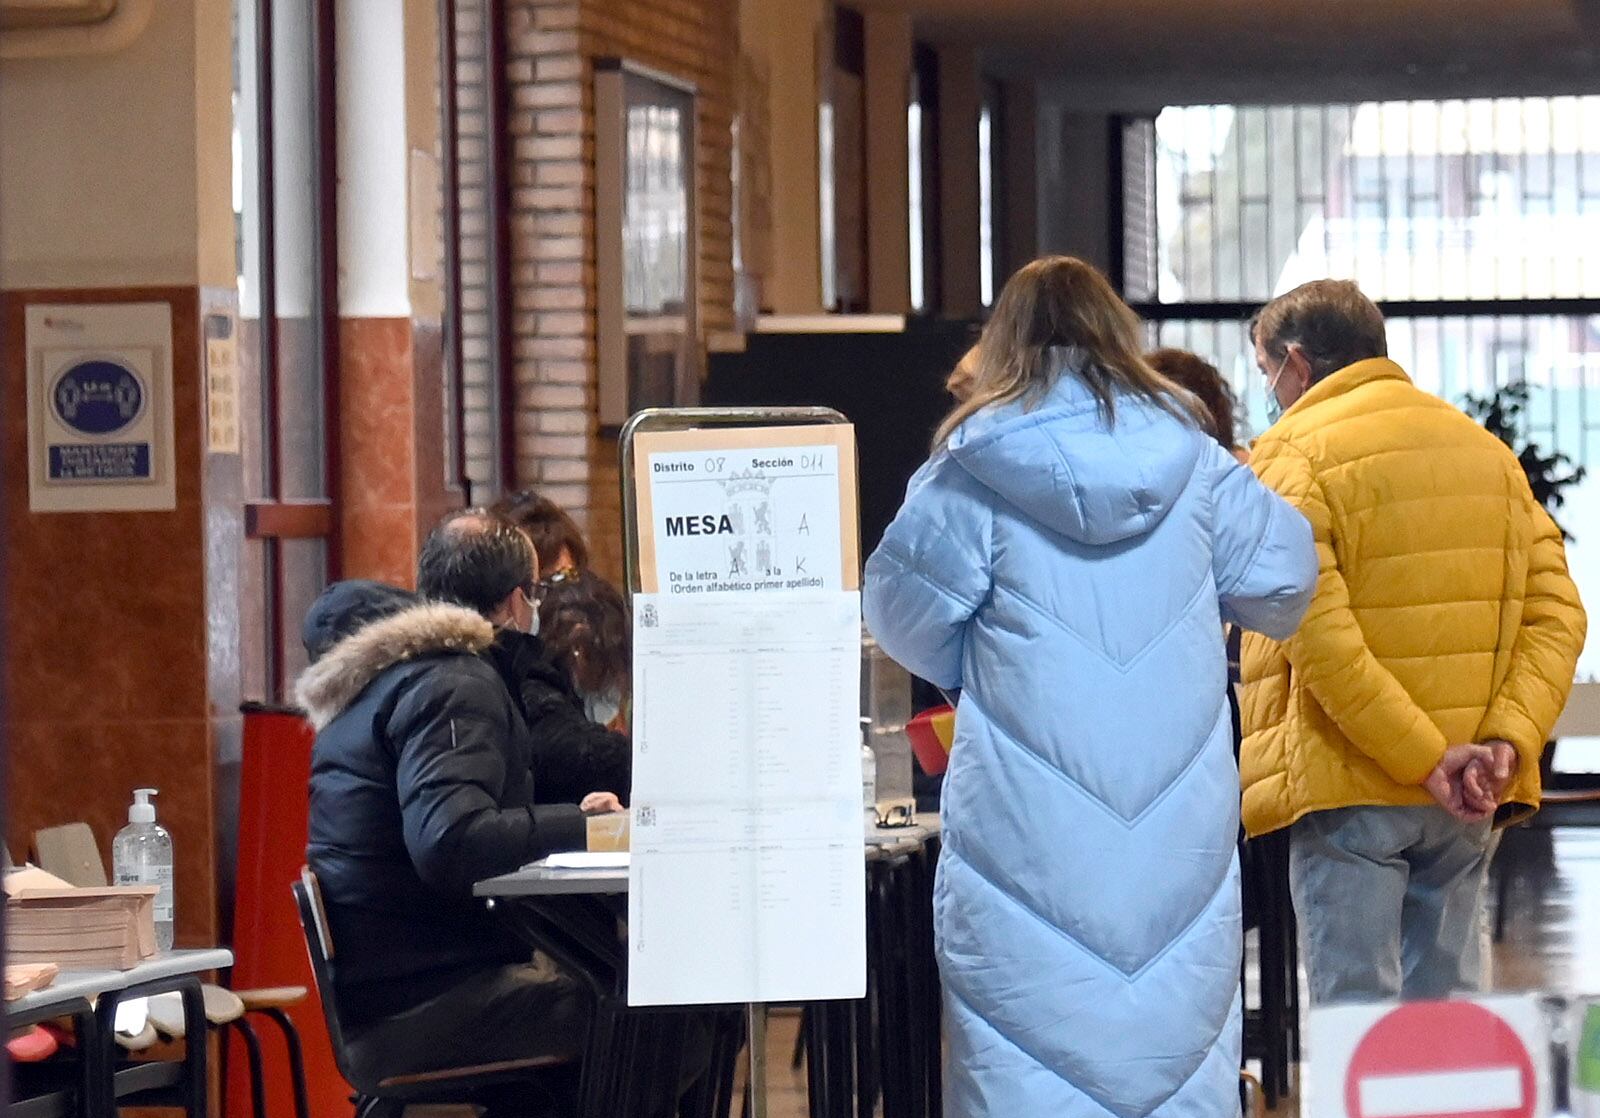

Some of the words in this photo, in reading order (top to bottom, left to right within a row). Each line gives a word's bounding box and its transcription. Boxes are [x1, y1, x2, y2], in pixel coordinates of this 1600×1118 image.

[654, 462, 695, 473] Distrito
[704, 457, 726, 473] 08
[751, 456, 794, 470] Sección
[665, 514, 734, 537] MESA
[798, 512, 810, 536] A
[669, 571, 682, 582] De
[685, 571, 694, 581] la
[696, 570, 718, 581] letra
[728, 557, 741, 579] A
[765, 568, 771, 576] a
[773, 566, 782, 576] la
[795, 555, 807, 575] K
[670, 582, 703, 594] (Orden
[706, 580, 752, 593] alfabético
[754, 579, 784, 592] primer
[786, 577, 825, 589] apellido)
